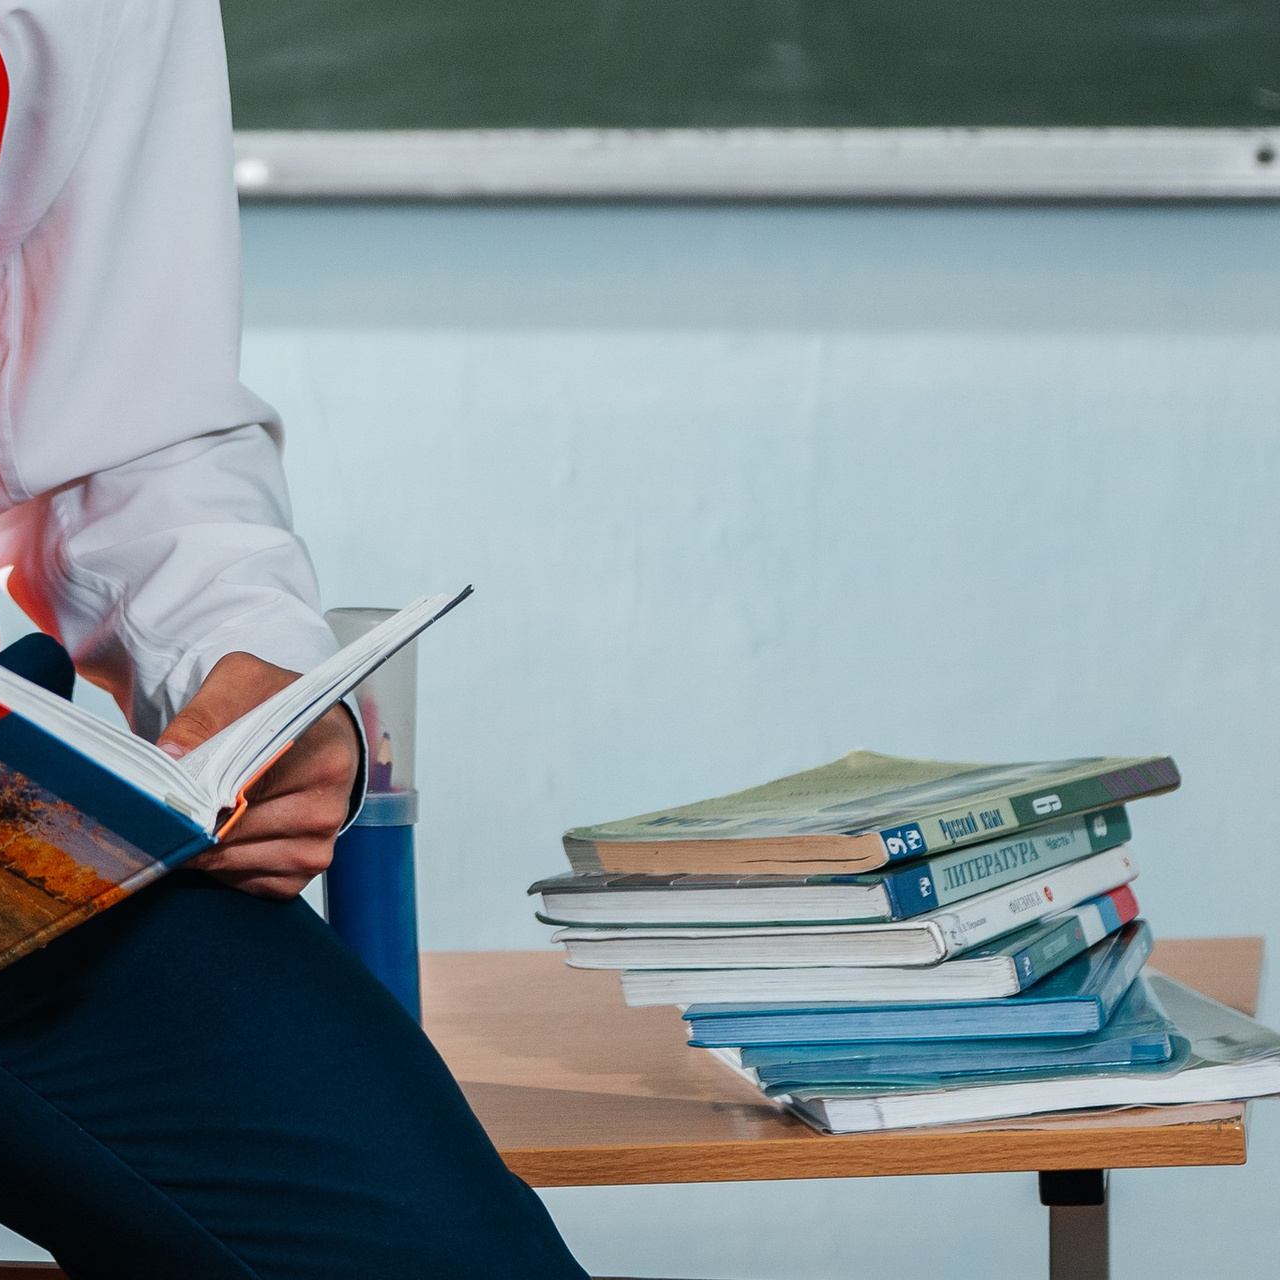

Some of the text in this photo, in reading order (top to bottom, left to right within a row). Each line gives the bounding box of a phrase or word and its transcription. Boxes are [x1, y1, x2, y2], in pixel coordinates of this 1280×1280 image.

[938, 811, 979, 845] Русский
[981, 807, 1006, 830] язык
[941, 840, 1041, 891] ЛИТЕРАТУРА
[1008, 890, 1044, 914] ФИЗИКА
